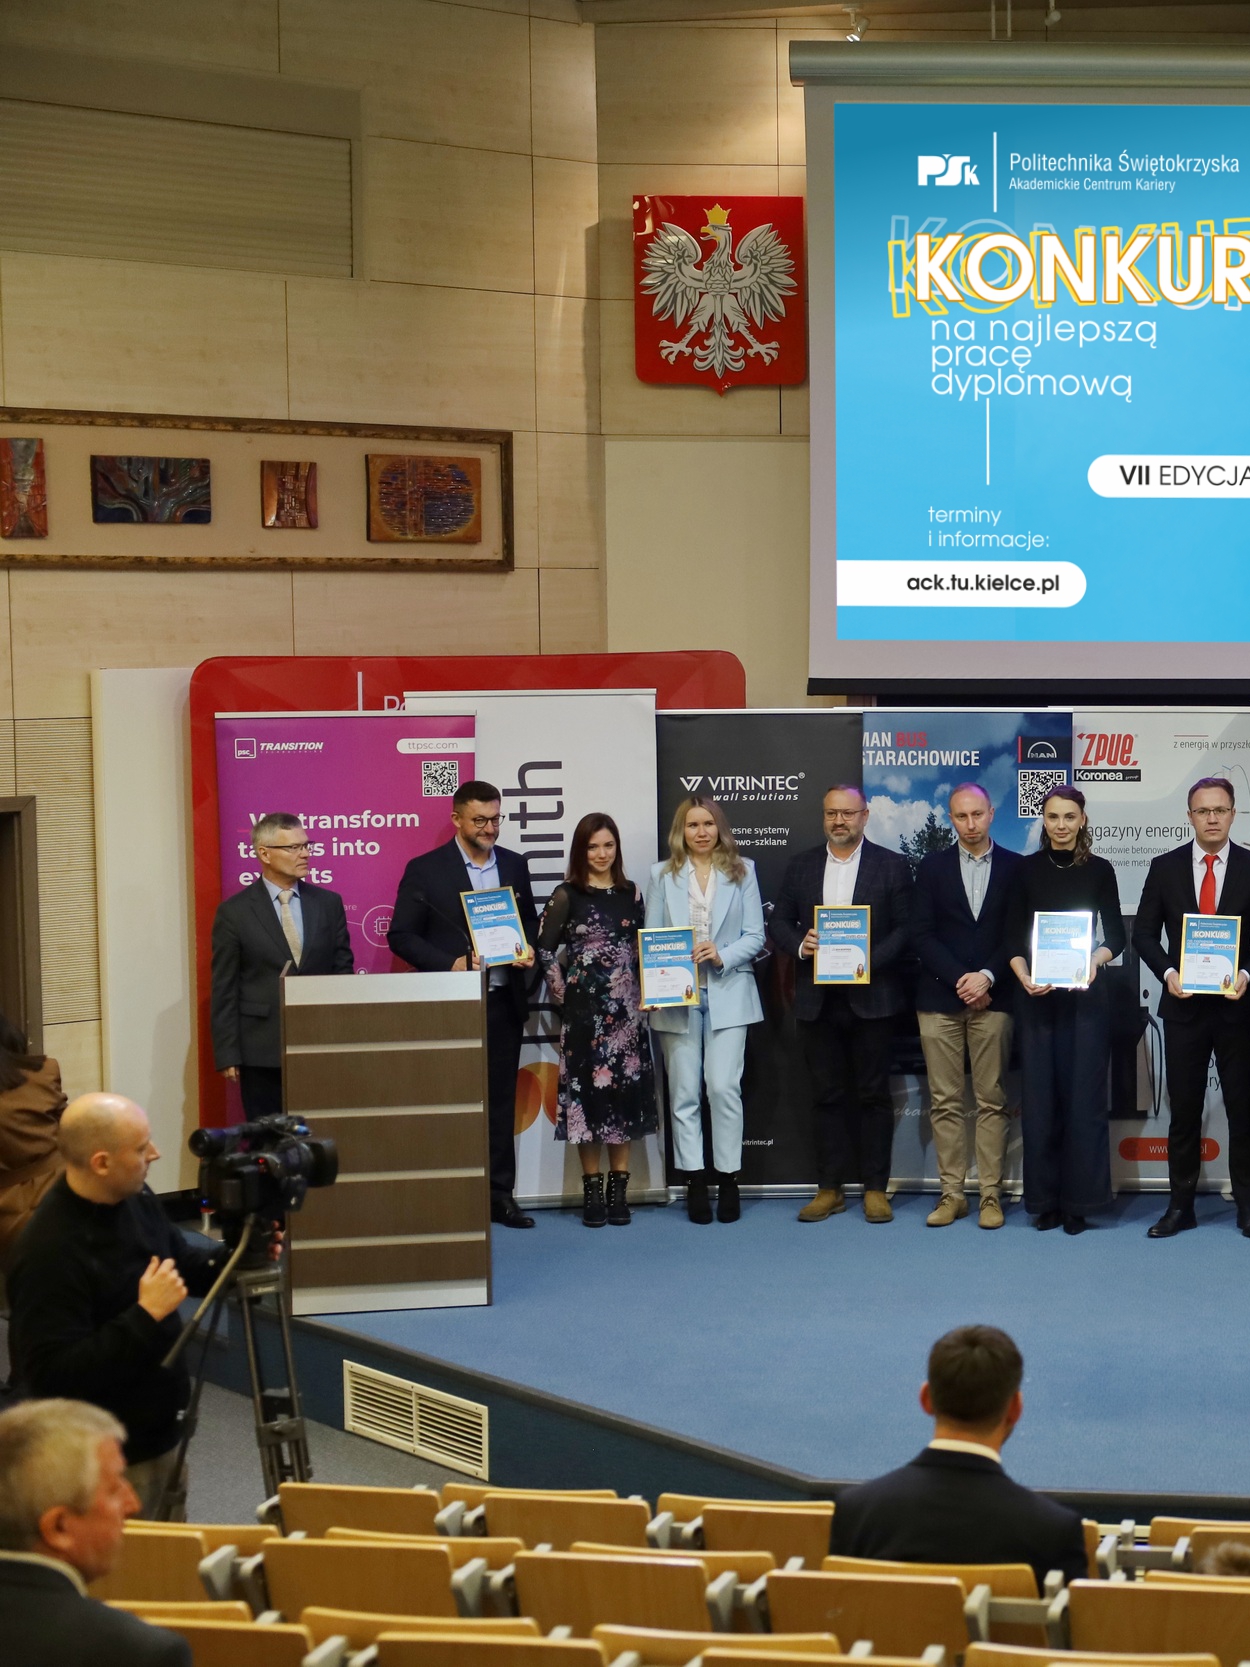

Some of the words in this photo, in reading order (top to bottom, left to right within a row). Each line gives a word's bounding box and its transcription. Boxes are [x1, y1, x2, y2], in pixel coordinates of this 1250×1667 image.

[1009, 152, 1113, 173] Politechnika
[1118, 149, 1240, 176] Świętokrzyska
[1009, 177, 1080, 191] Akademickie
[1083, 178, 1133, 191] Centrum
[1136, 179, 1176, 194] Kariery
[931, 318, 976, 342] na
[989, 314, 1158, 350] najlepszą
[931, 344, 1032, 373] pracę
[931, 368, 1133, 403] dyplomową
[1119, 465, 1151, 487] VII
[928, 507, 1002, 527] terminy
[928, 531, 933, 547] i
[938, 530, 1050, 551] informacje:
[906, 574, 1060, 595] ack.tu.kielce.pl
[260, 742, 323, 751] TRANSITION
[408, 741, 458, 750] ttpsc.com
[896, 732, 927, 748] BUS
[1180, 740, 1209, 750] energią
[1076, 770, 1123, 781] Koronea
[713, 793, 739, 801] wall
[743, 793, 799, 801] solutions
[301, 810, 419, 829] transform
[754, 826, 790, 836] systemy
[1087, 826, 1142, 841] agazyny
[1145, 822, 1190, 841] energii
[332, 837, 381, 856] into
[824, 921, 861, 929] KONKURS
[1193, 930, 1230, 939] KONKURS
